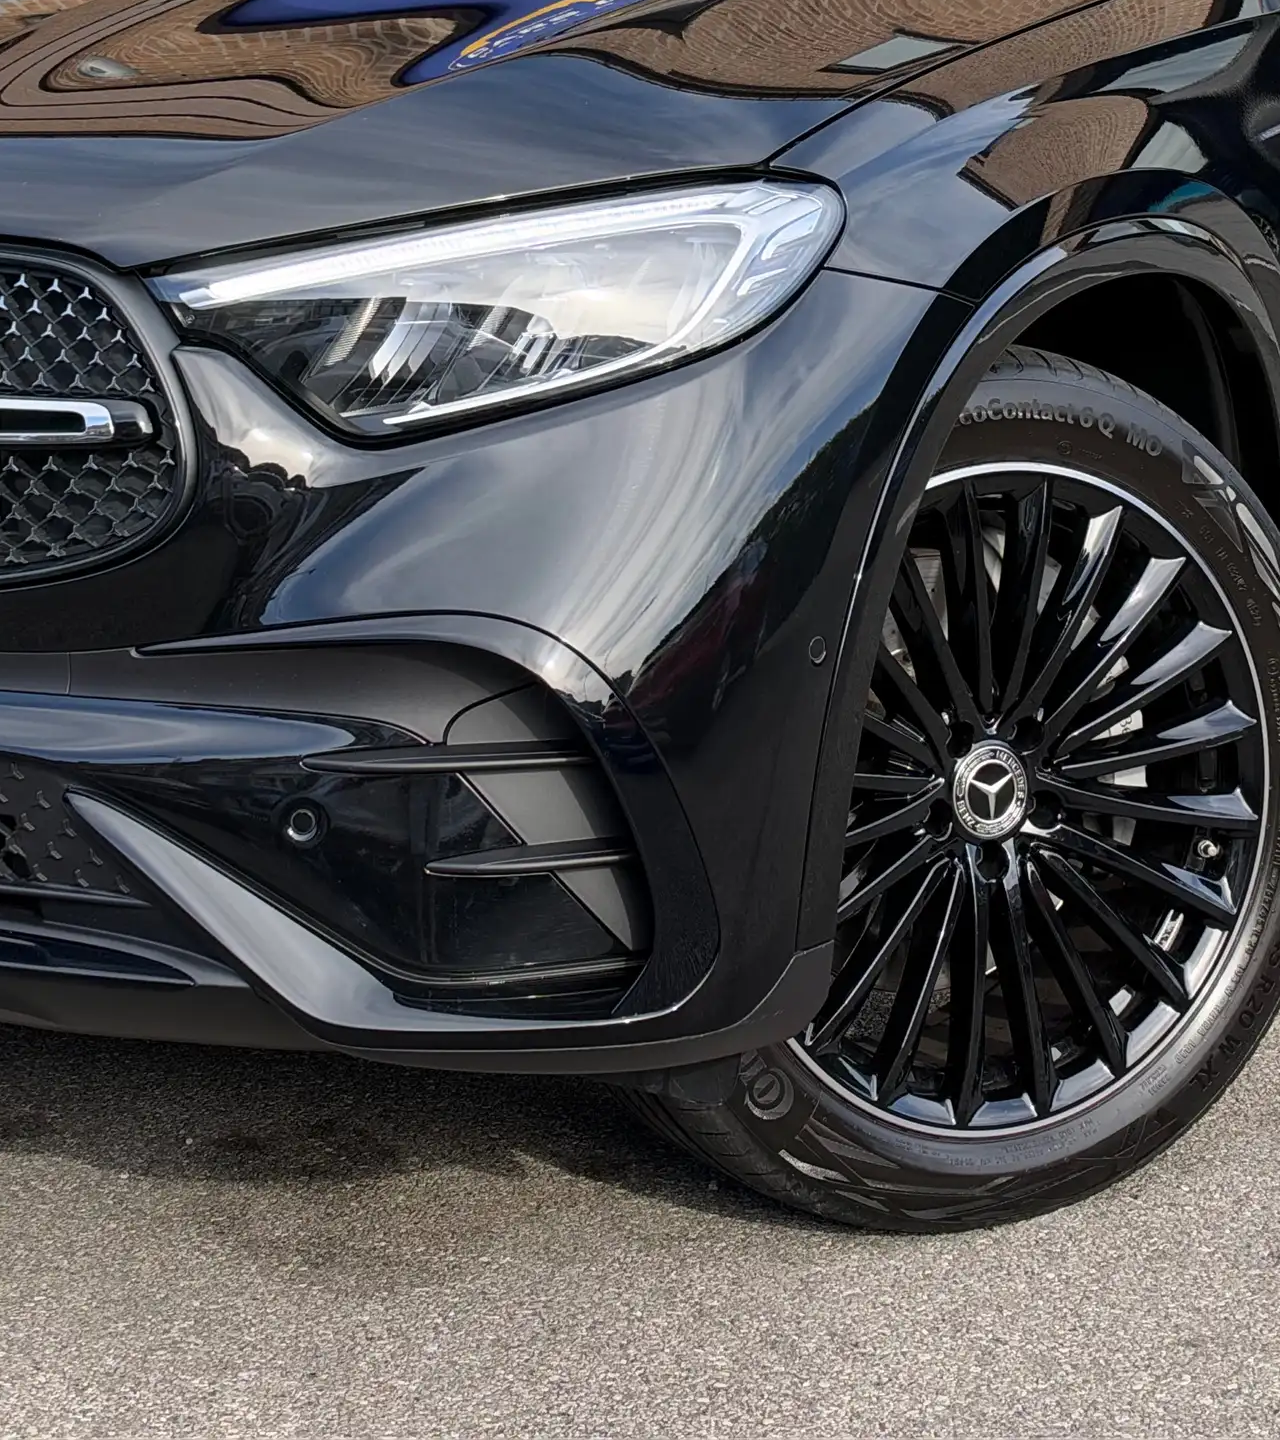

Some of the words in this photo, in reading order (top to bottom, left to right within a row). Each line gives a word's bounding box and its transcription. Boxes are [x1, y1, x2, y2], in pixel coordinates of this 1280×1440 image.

[1079, 406, 1094, 428] 6
[1098, 412, 1117, 439] Q
[1125, 422, 1163, 457] MO
[995, 749, 1025, 799] MERCEDES
[956, 800, 975, 829] BENZ
[1189, 1054, 1220, 1092] XL
